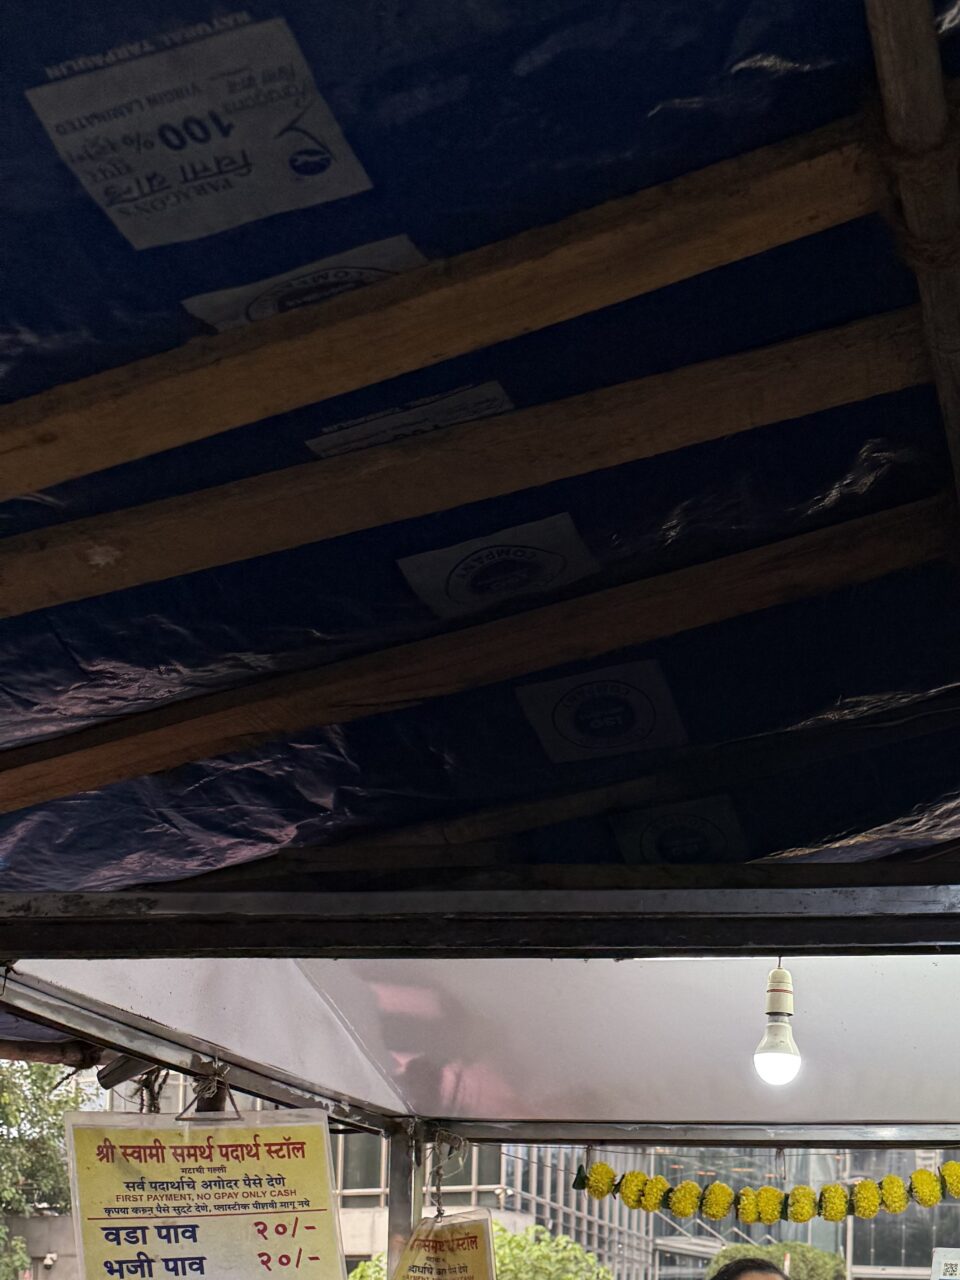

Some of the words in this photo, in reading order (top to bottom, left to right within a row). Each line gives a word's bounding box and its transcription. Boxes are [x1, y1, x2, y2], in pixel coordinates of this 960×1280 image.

[155, 109, 237, 156] 100
[96, 1137, 115, 1163] श्री
[120, 1137, 166, 1164] स्वामी
[170, 1136, 214, 1163] समर्थ
[217, 1134, 261, 1163] पदार्थ
[264, 1136, 306, 1160] स्टॉल
[116, 1194, 144, 1203] FIRST
[146, 1193, 195, 1203] PAYMENT,
[197, 1192, 211, 1201] NO
[214, 1191, 240, 1200] GPAY
[242, 1190, 269, 1200] ONLY
[271, 1188, 297, 1197] CASH
[123, 1176, 146, 1192] सर्व
[149, 1176, 197, 1192] पदार्थाचे
[201, 1175, 239, 1190] अगोदर
[242, 1173, 263, 1188] पैसे
[265, 1173, 286, 1187] देणे
[100, 1224, 149, 1246] वडा
[154, 1223, 200, 1244] पाव
[104, 1251, 155, 1280] भजी
[161, 1254, 207, 1275] पाव
